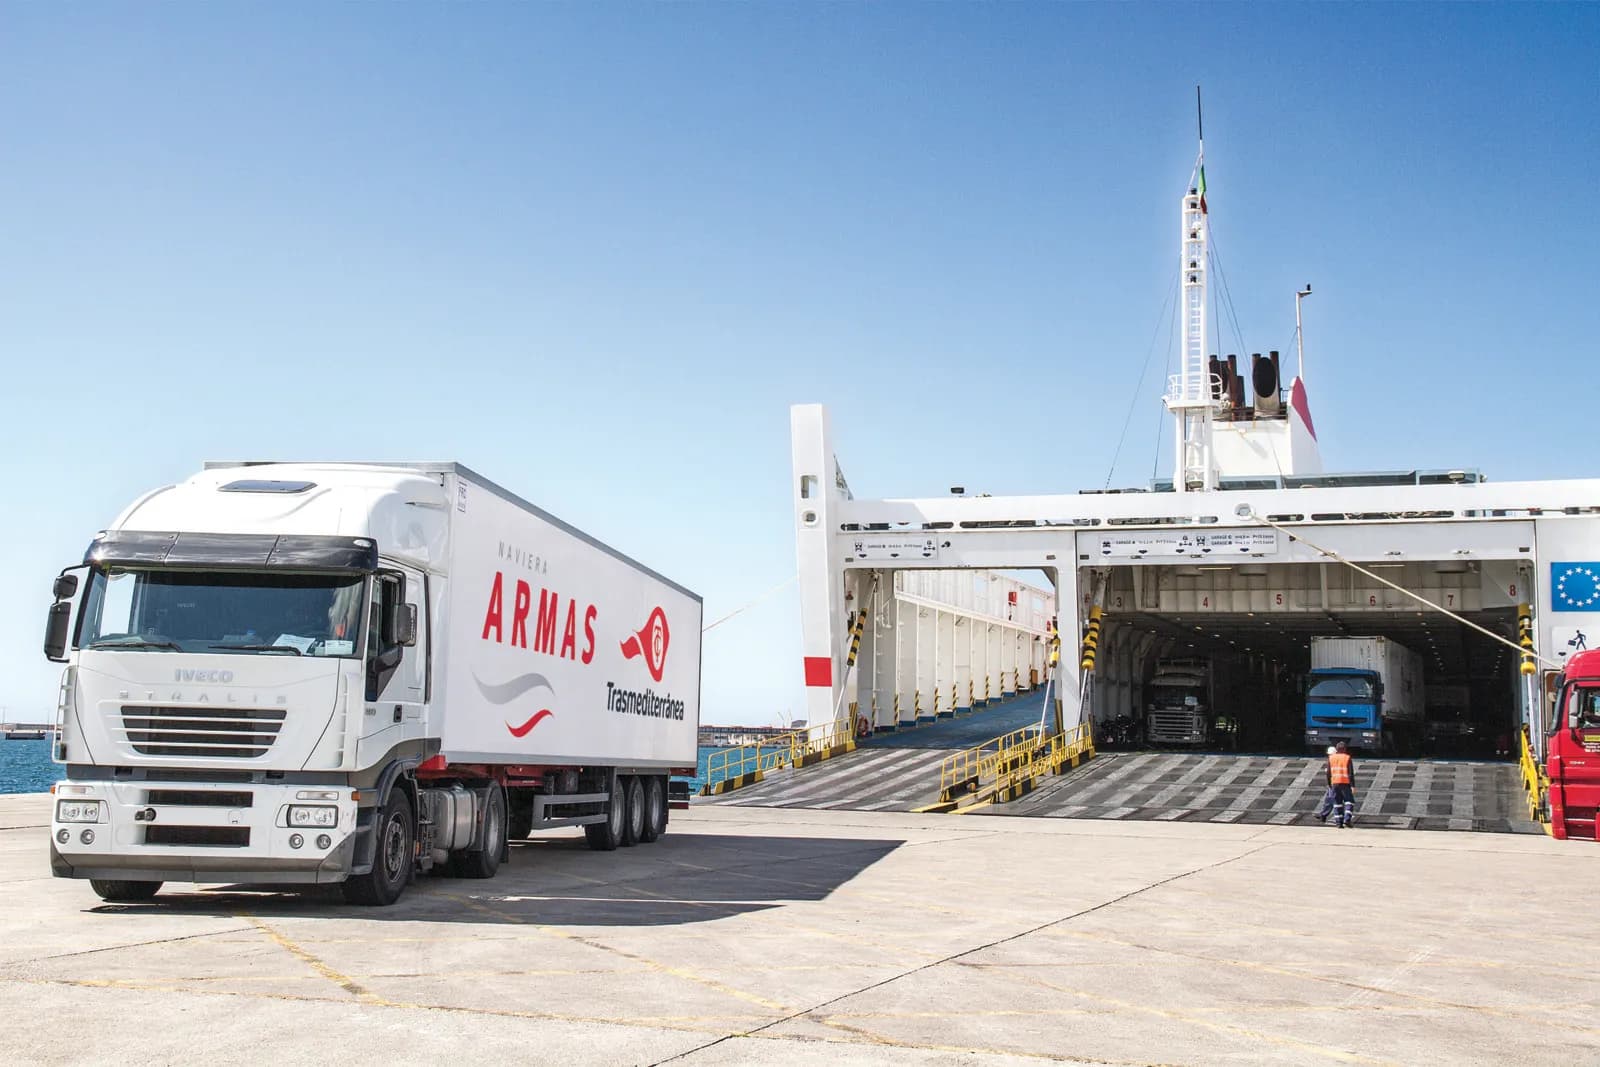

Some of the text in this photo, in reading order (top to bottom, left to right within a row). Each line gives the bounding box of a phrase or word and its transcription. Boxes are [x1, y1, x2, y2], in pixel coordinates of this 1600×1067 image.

[499, 541, 548, 575] NAVIERA
[1509, 585, 1516, 596] 8
[1116, 597, 1122, 608] 3
[1203, 597, 1209, 608] 4
[1276, 594, 1283, 605] 5
[1370, 596, 1376, 606] 6
[1448, 595, 1454, 606] 7
[482, 571, 598, 665] ARMAS
[175, 669, 233, 683] IVECO
[120, 691, 287, 704] STRALIS
[606, 681, 684, 720] Trasmediterránea
